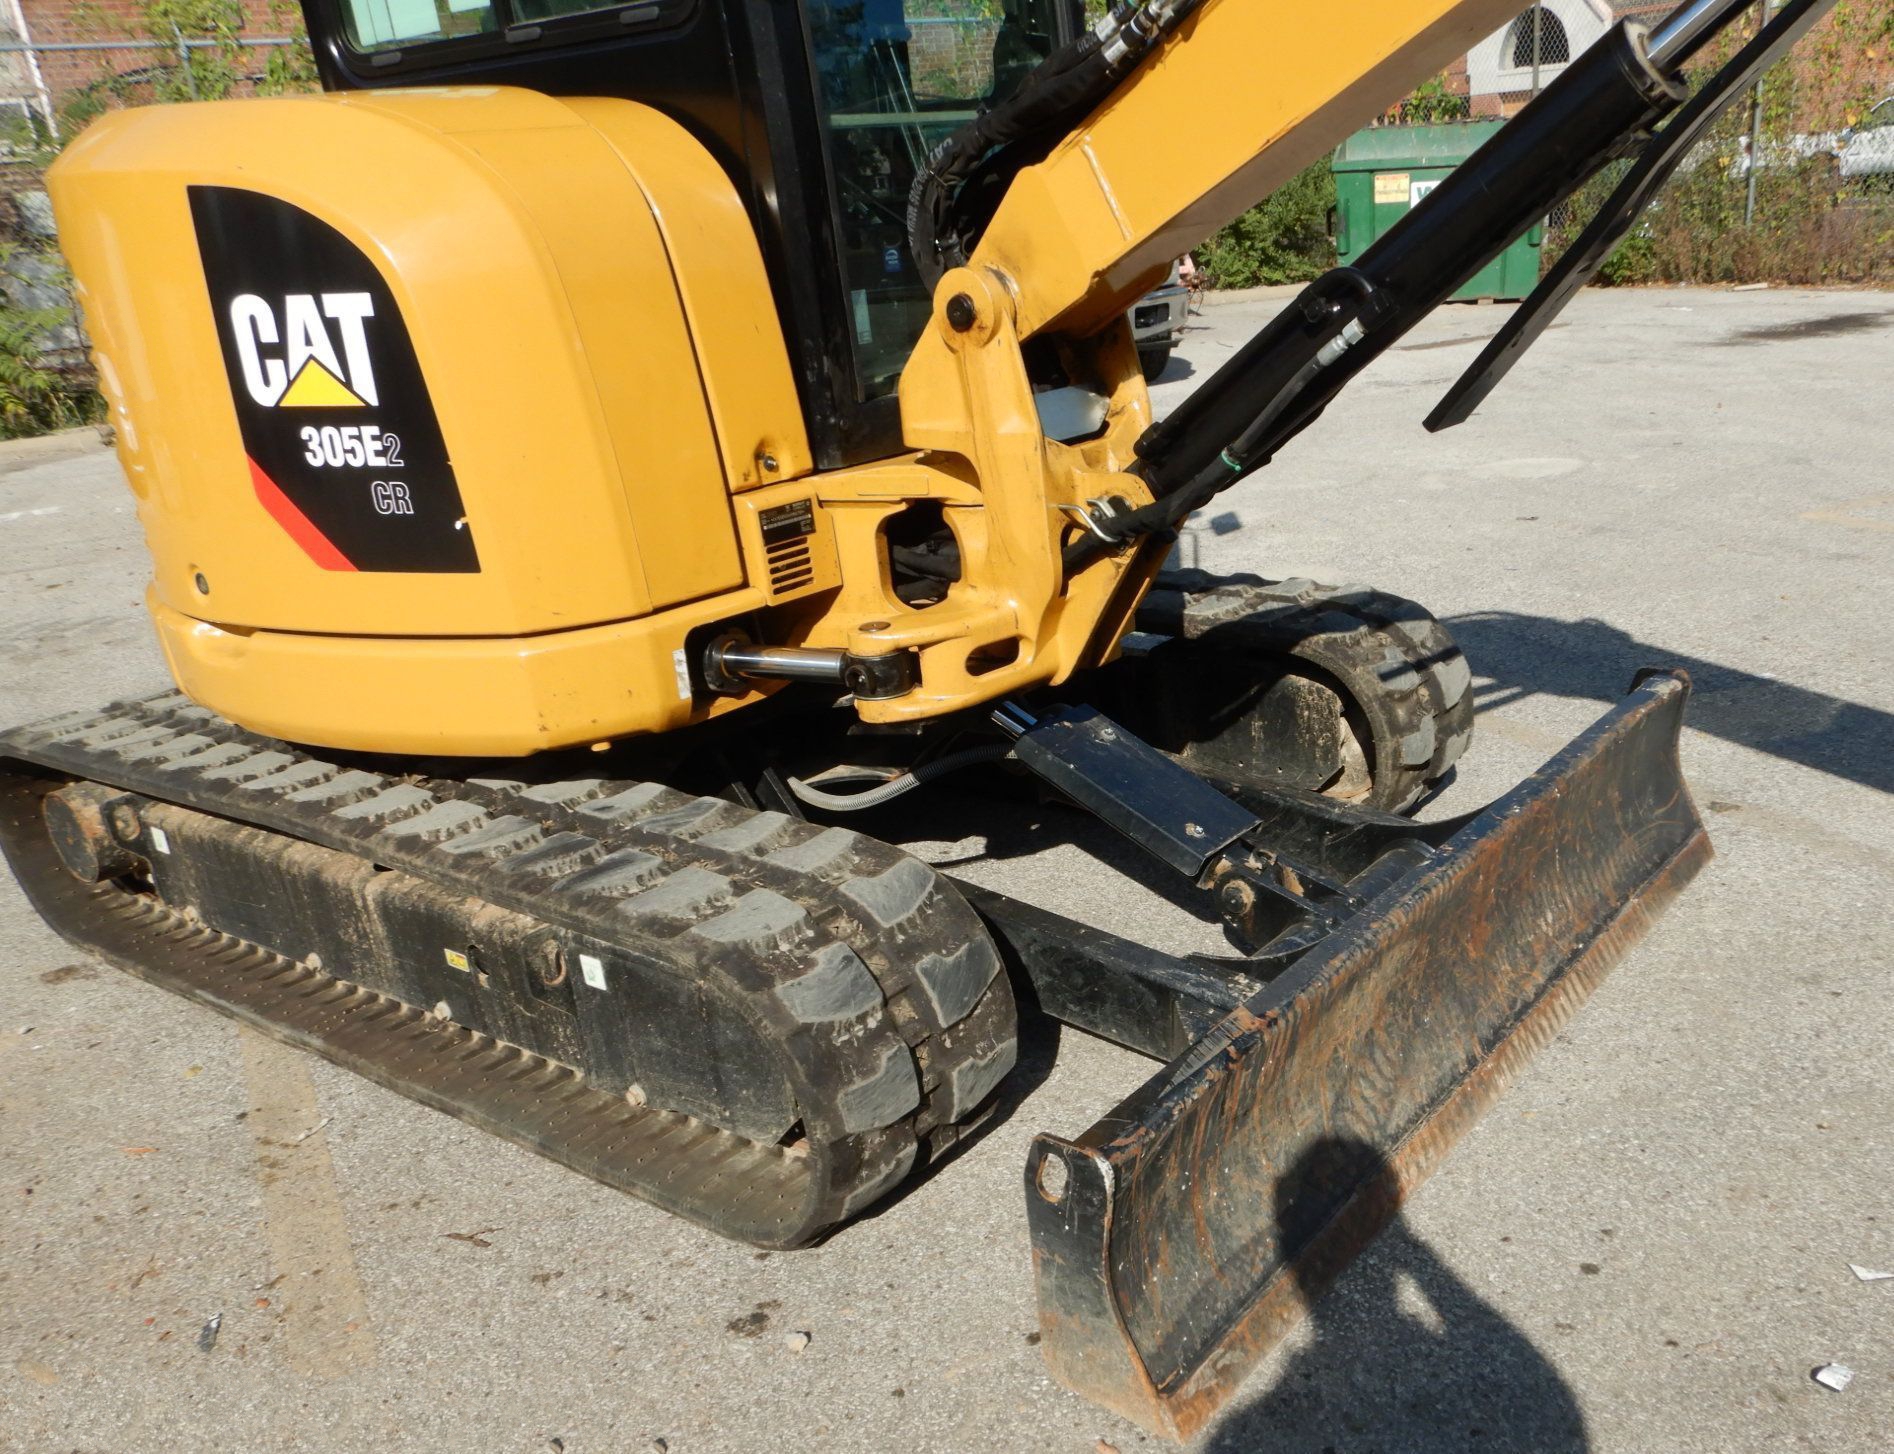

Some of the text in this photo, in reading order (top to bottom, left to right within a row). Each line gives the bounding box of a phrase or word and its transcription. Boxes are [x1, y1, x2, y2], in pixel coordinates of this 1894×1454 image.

[230, 292, 379, 407] CAT
[301, 426, 404, 467] 305E2
[371, 481, 414, 514] CR
